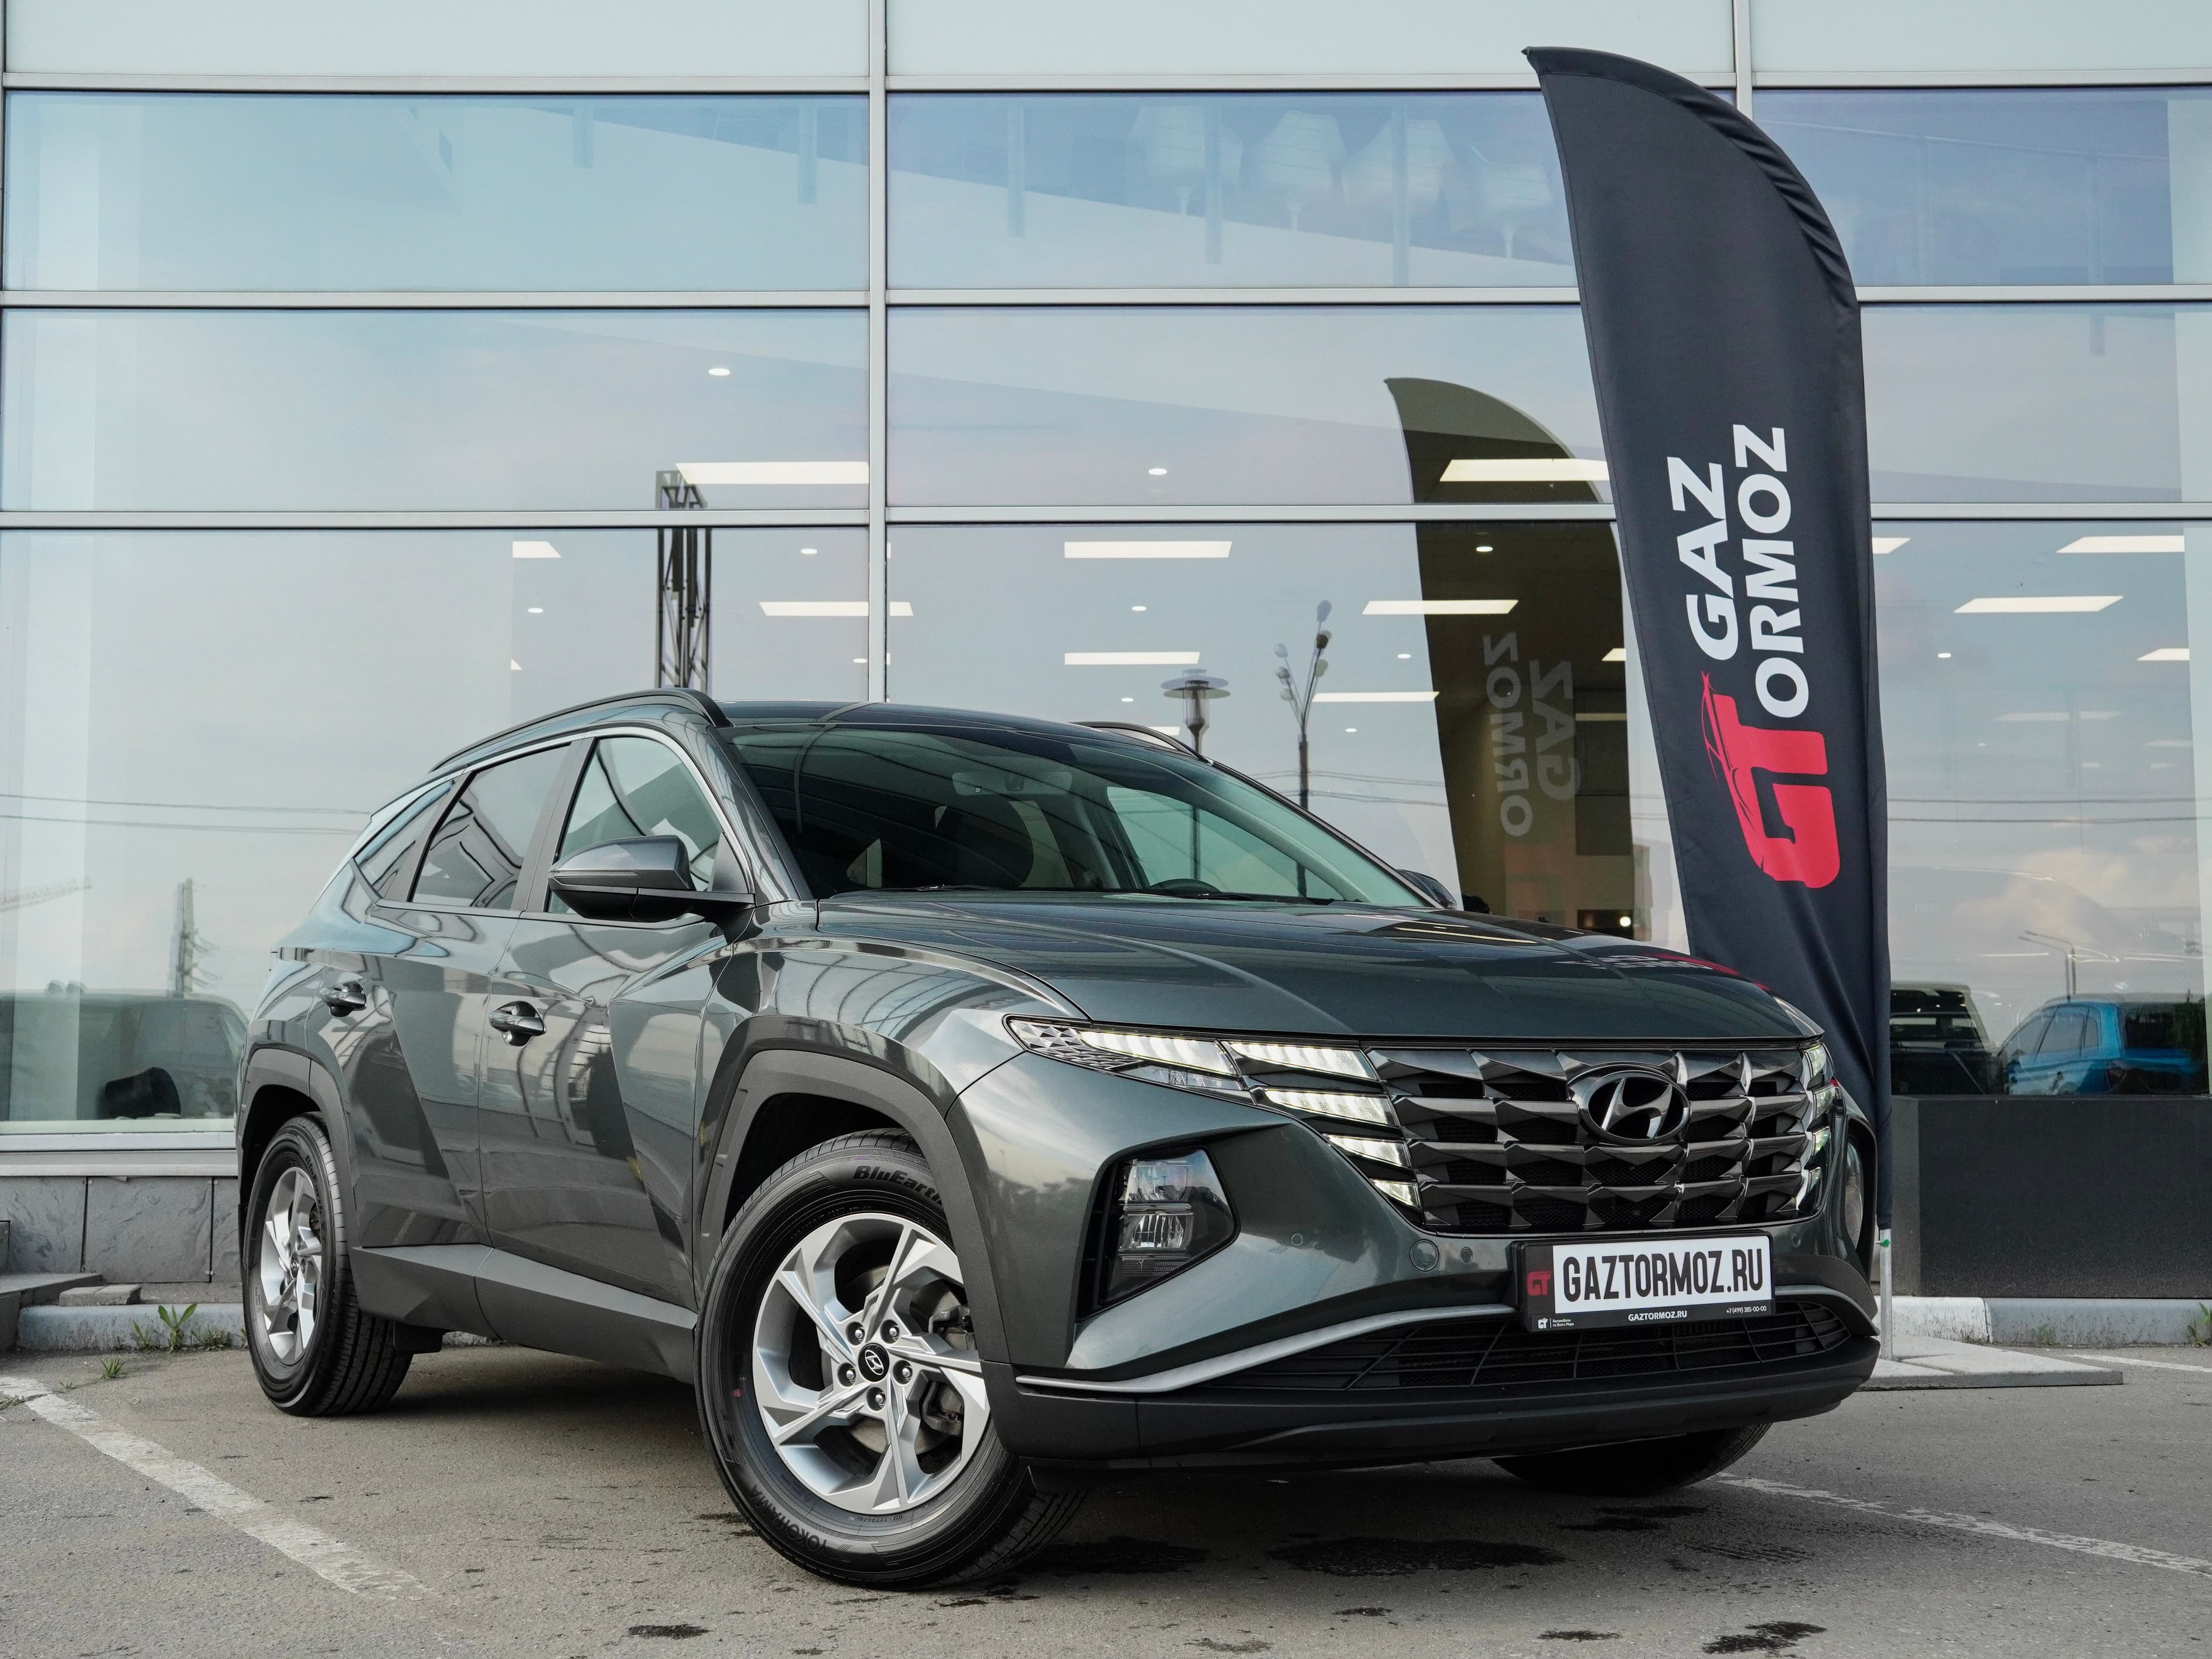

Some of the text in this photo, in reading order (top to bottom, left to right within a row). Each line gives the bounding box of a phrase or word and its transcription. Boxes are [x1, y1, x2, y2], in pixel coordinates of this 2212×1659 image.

[1667, 456, 1739, 661] GAZ
[1563, 1248, 1763, 1302] GAZTORMOZ.RU
[1628, 1310, 1688, 1322] GAZTORMOZ.RU
[749, 1484, 828, 1556] YOKOHAMA
